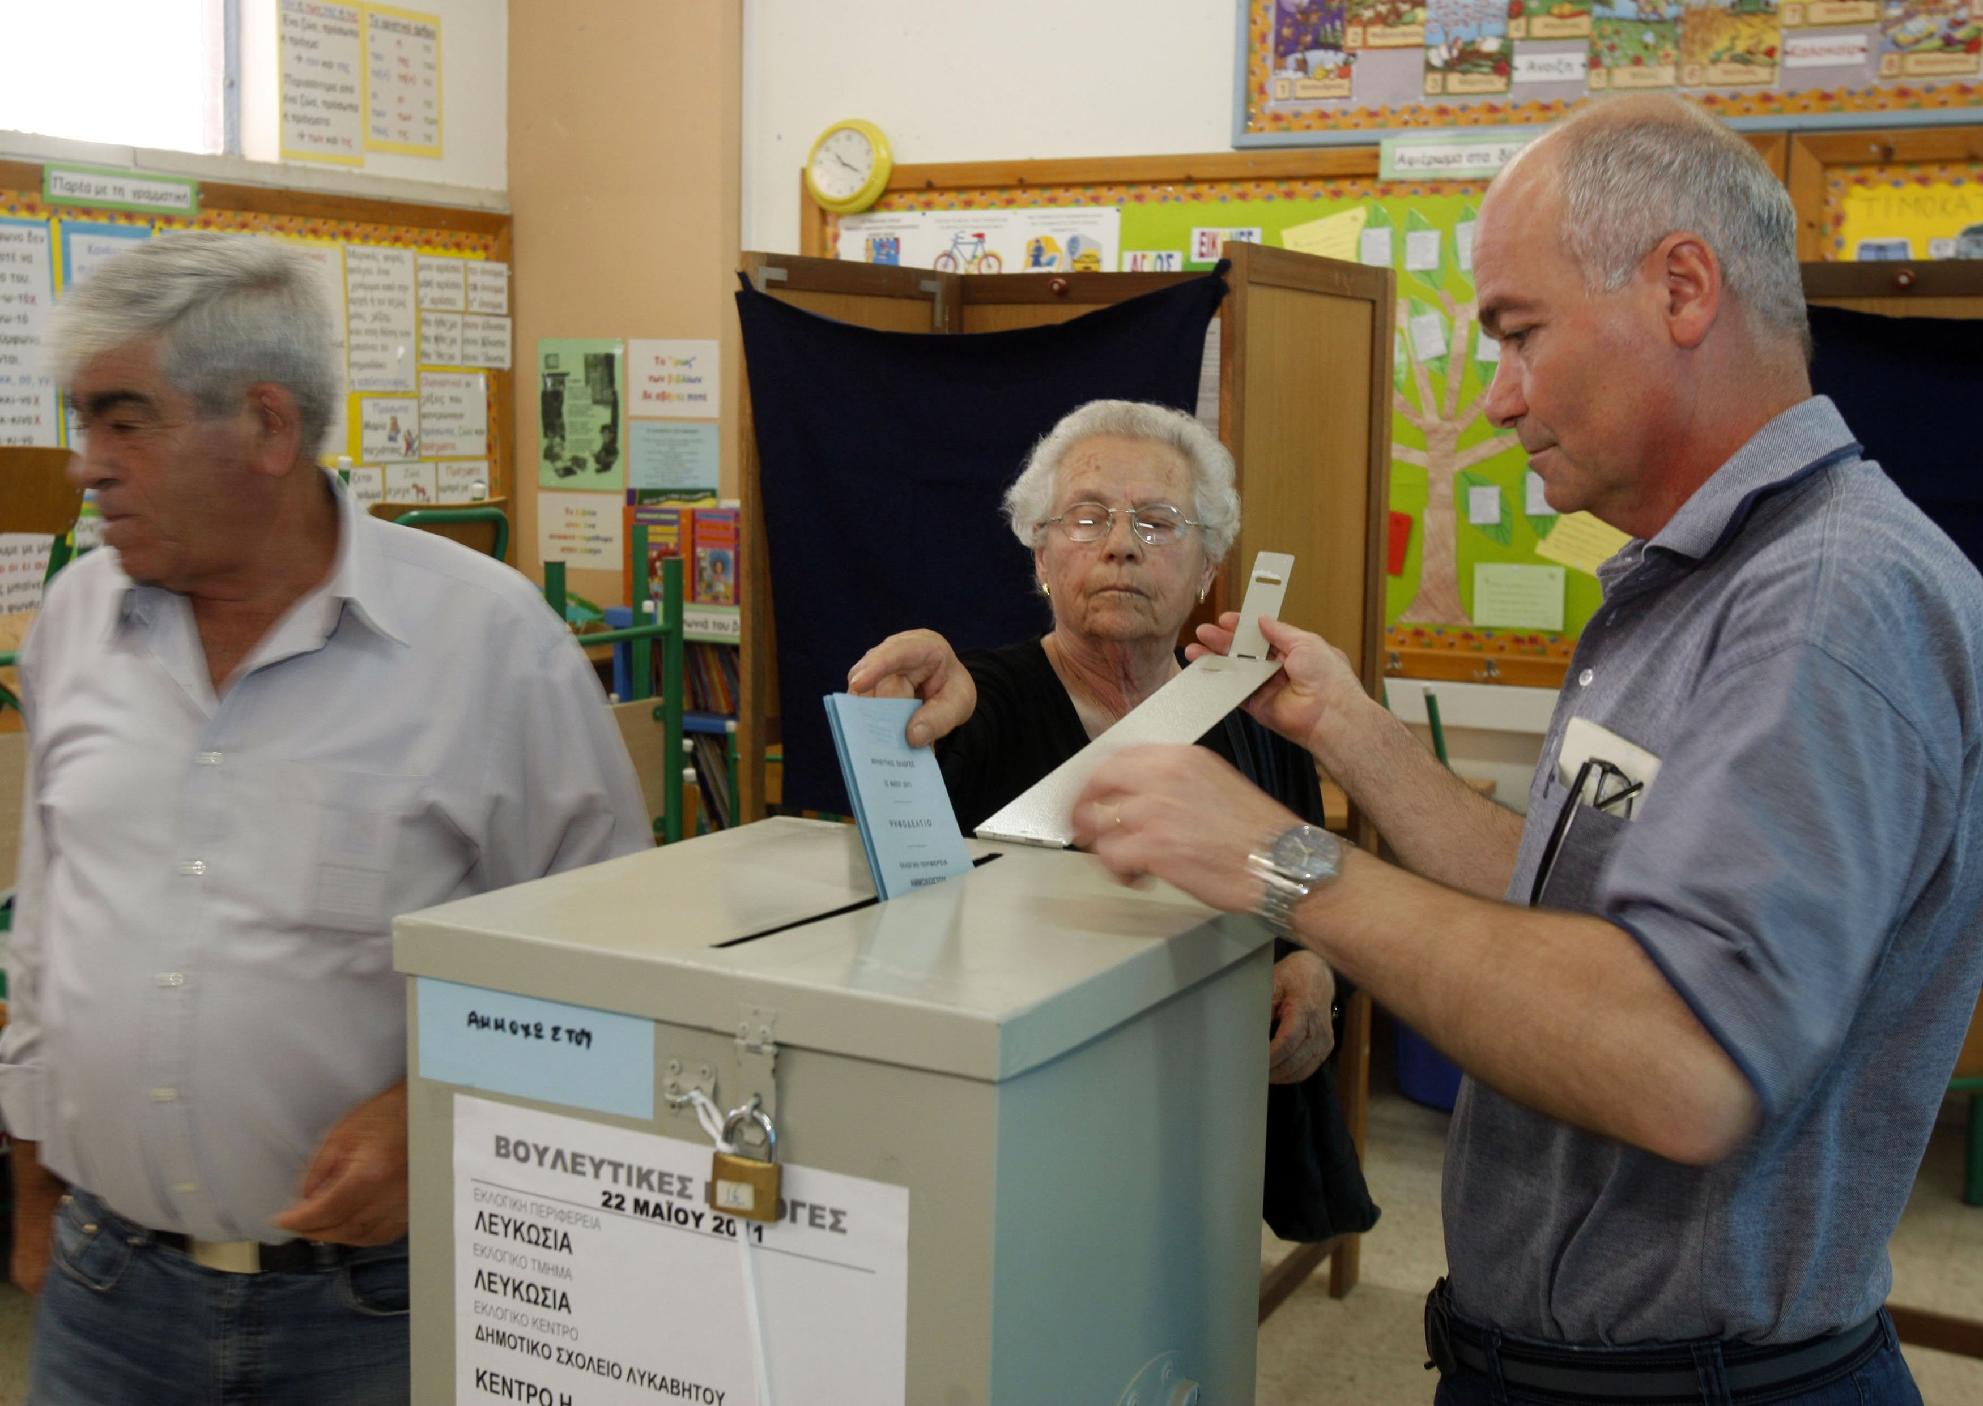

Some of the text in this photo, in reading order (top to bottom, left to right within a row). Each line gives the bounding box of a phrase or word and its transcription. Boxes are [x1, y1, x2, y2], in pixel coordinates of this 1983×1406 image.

[53, 175, 91, 195] Παρέα
[94, 184, 108, 195] με
[112, 186, 126, 199] τη
[711, 619, 729, 631] του
[494, 1134, 694, 1201] ΒΟΥΛΕΥΤΙΚΕΣ
[473, 1187, 602, 1232] ΕΚΛΟΓΙΚΗ ΠΕΡΙΦΕΡΕΙΑ
[601, 1191, 764, 1244] 22 ΜΑΪΟΥ 201
[474, 1211, 574, 1256] ΛΕΥΚΩΣΙΑ
[473, 1243, 574, 1282] ΕΚΛΟΓΙΚΟ ΤΜΗΜΑ
[474, 1269, 573, 1315] ΛΕΥΚΩΣΙΑ
[473, 1300, 580, 1342] ΕΚΛΟΓΙΚΟ ΚΕΝΤΡΟ
[475, 1324, 726, 1406] ΔΗΜΟΤΙΚΟ ΣΧΟΛΕΙΟ ΛΥΚΑΒΗΤΟΥ
[475, 1367, 554, 1406] ΚΕΝΤΡΟ
